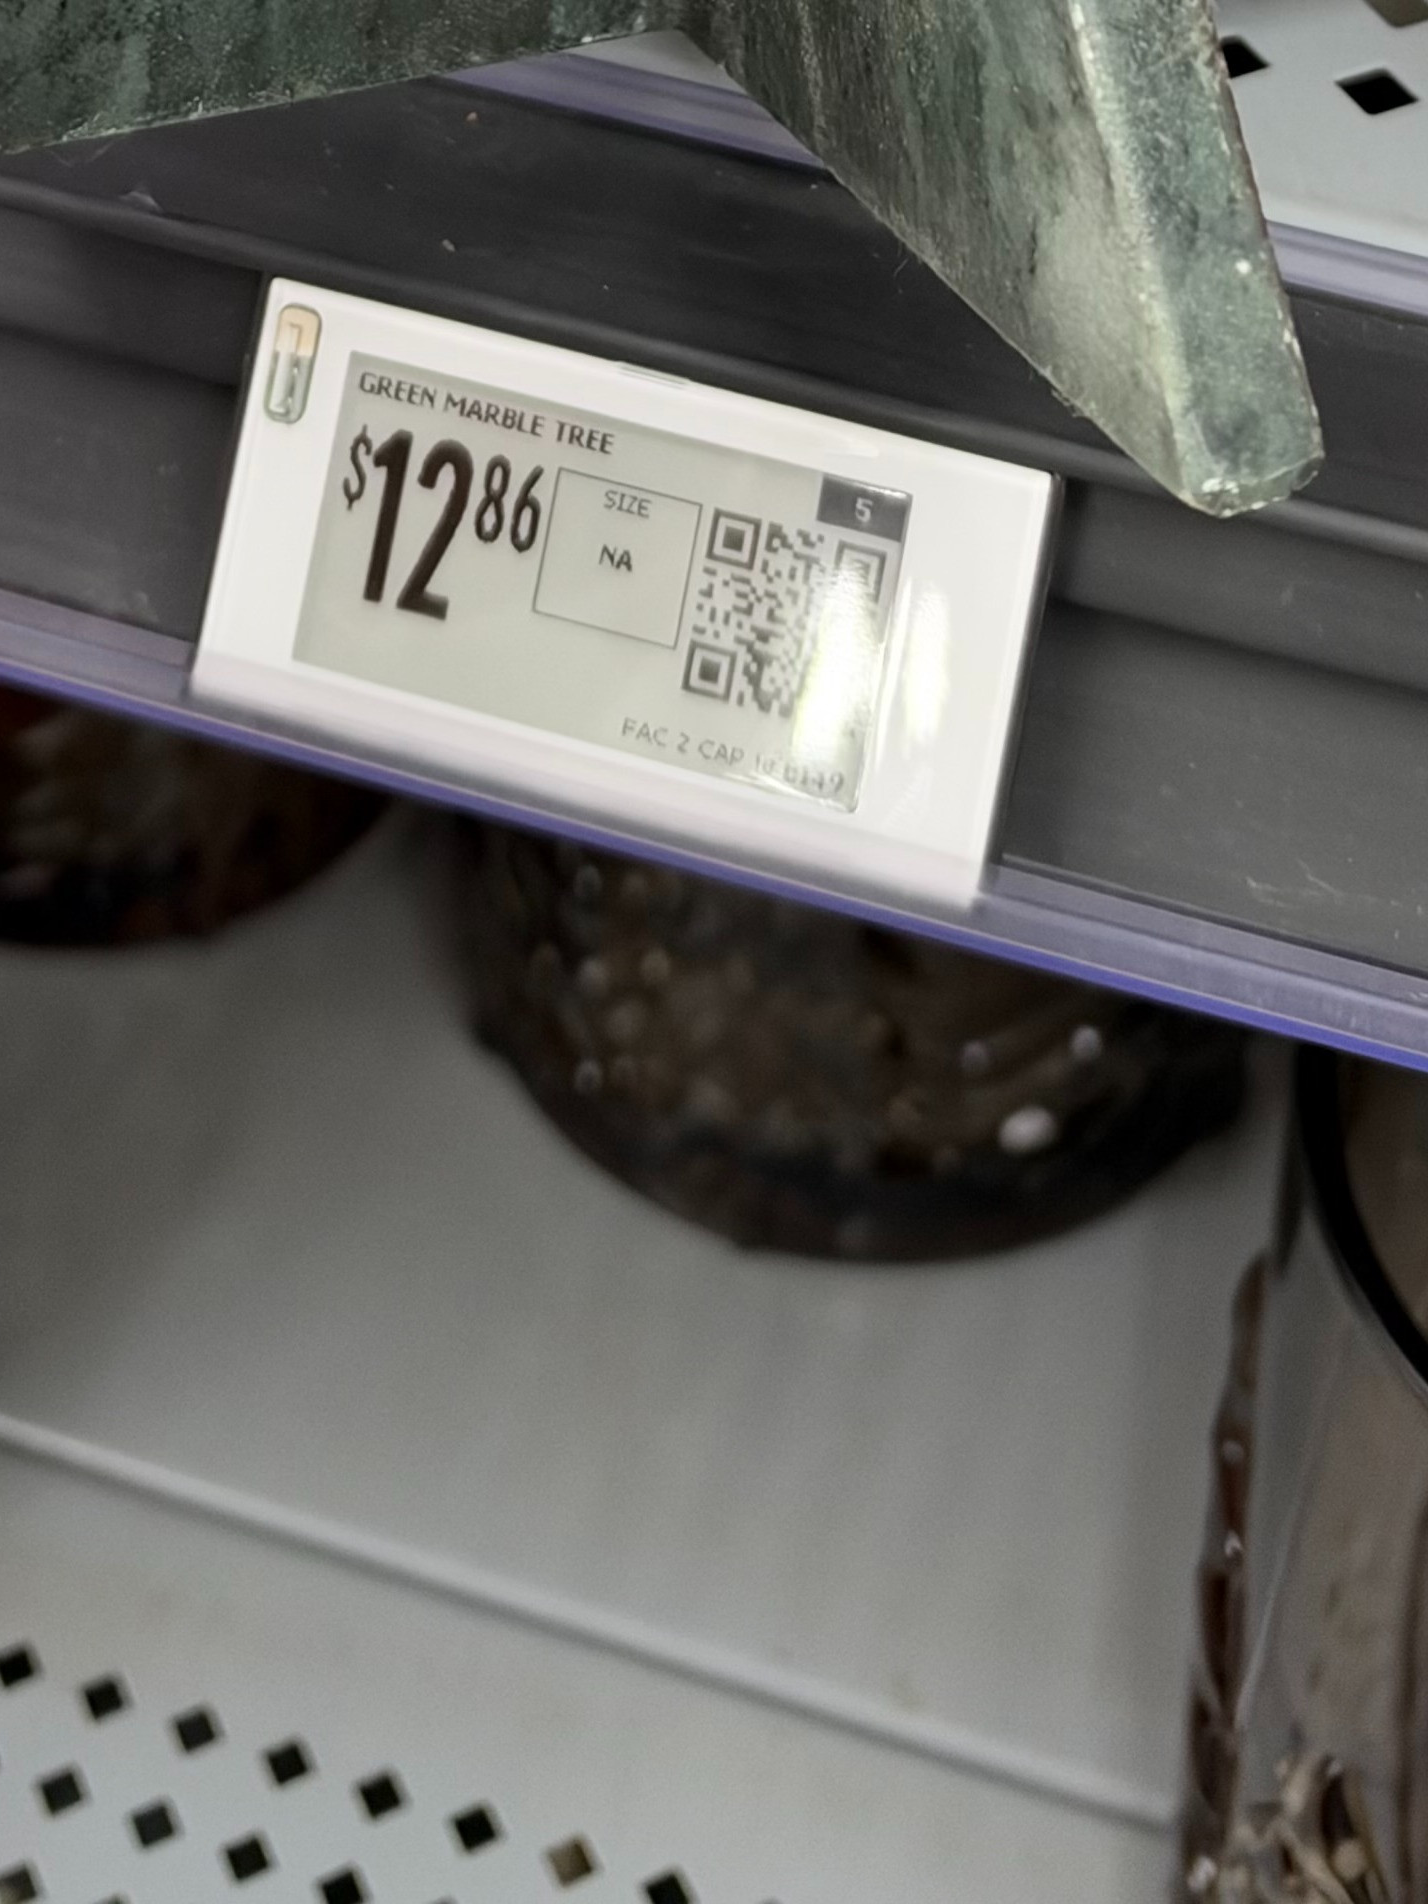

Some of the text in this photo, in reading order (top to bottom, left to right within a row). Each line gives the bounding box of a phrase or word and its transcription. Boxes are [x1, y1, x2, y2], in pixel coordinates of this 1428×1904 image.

[358, 371, 615, 455] GREEN MARBLE TREE
[603, 489, 652, 519] SIZE
[598, 544, 634, 573] NA
[621, 716, 669, 748] FAC
[677, 732, 690, 755] 2
[697, 739, 745, 767] CAP
